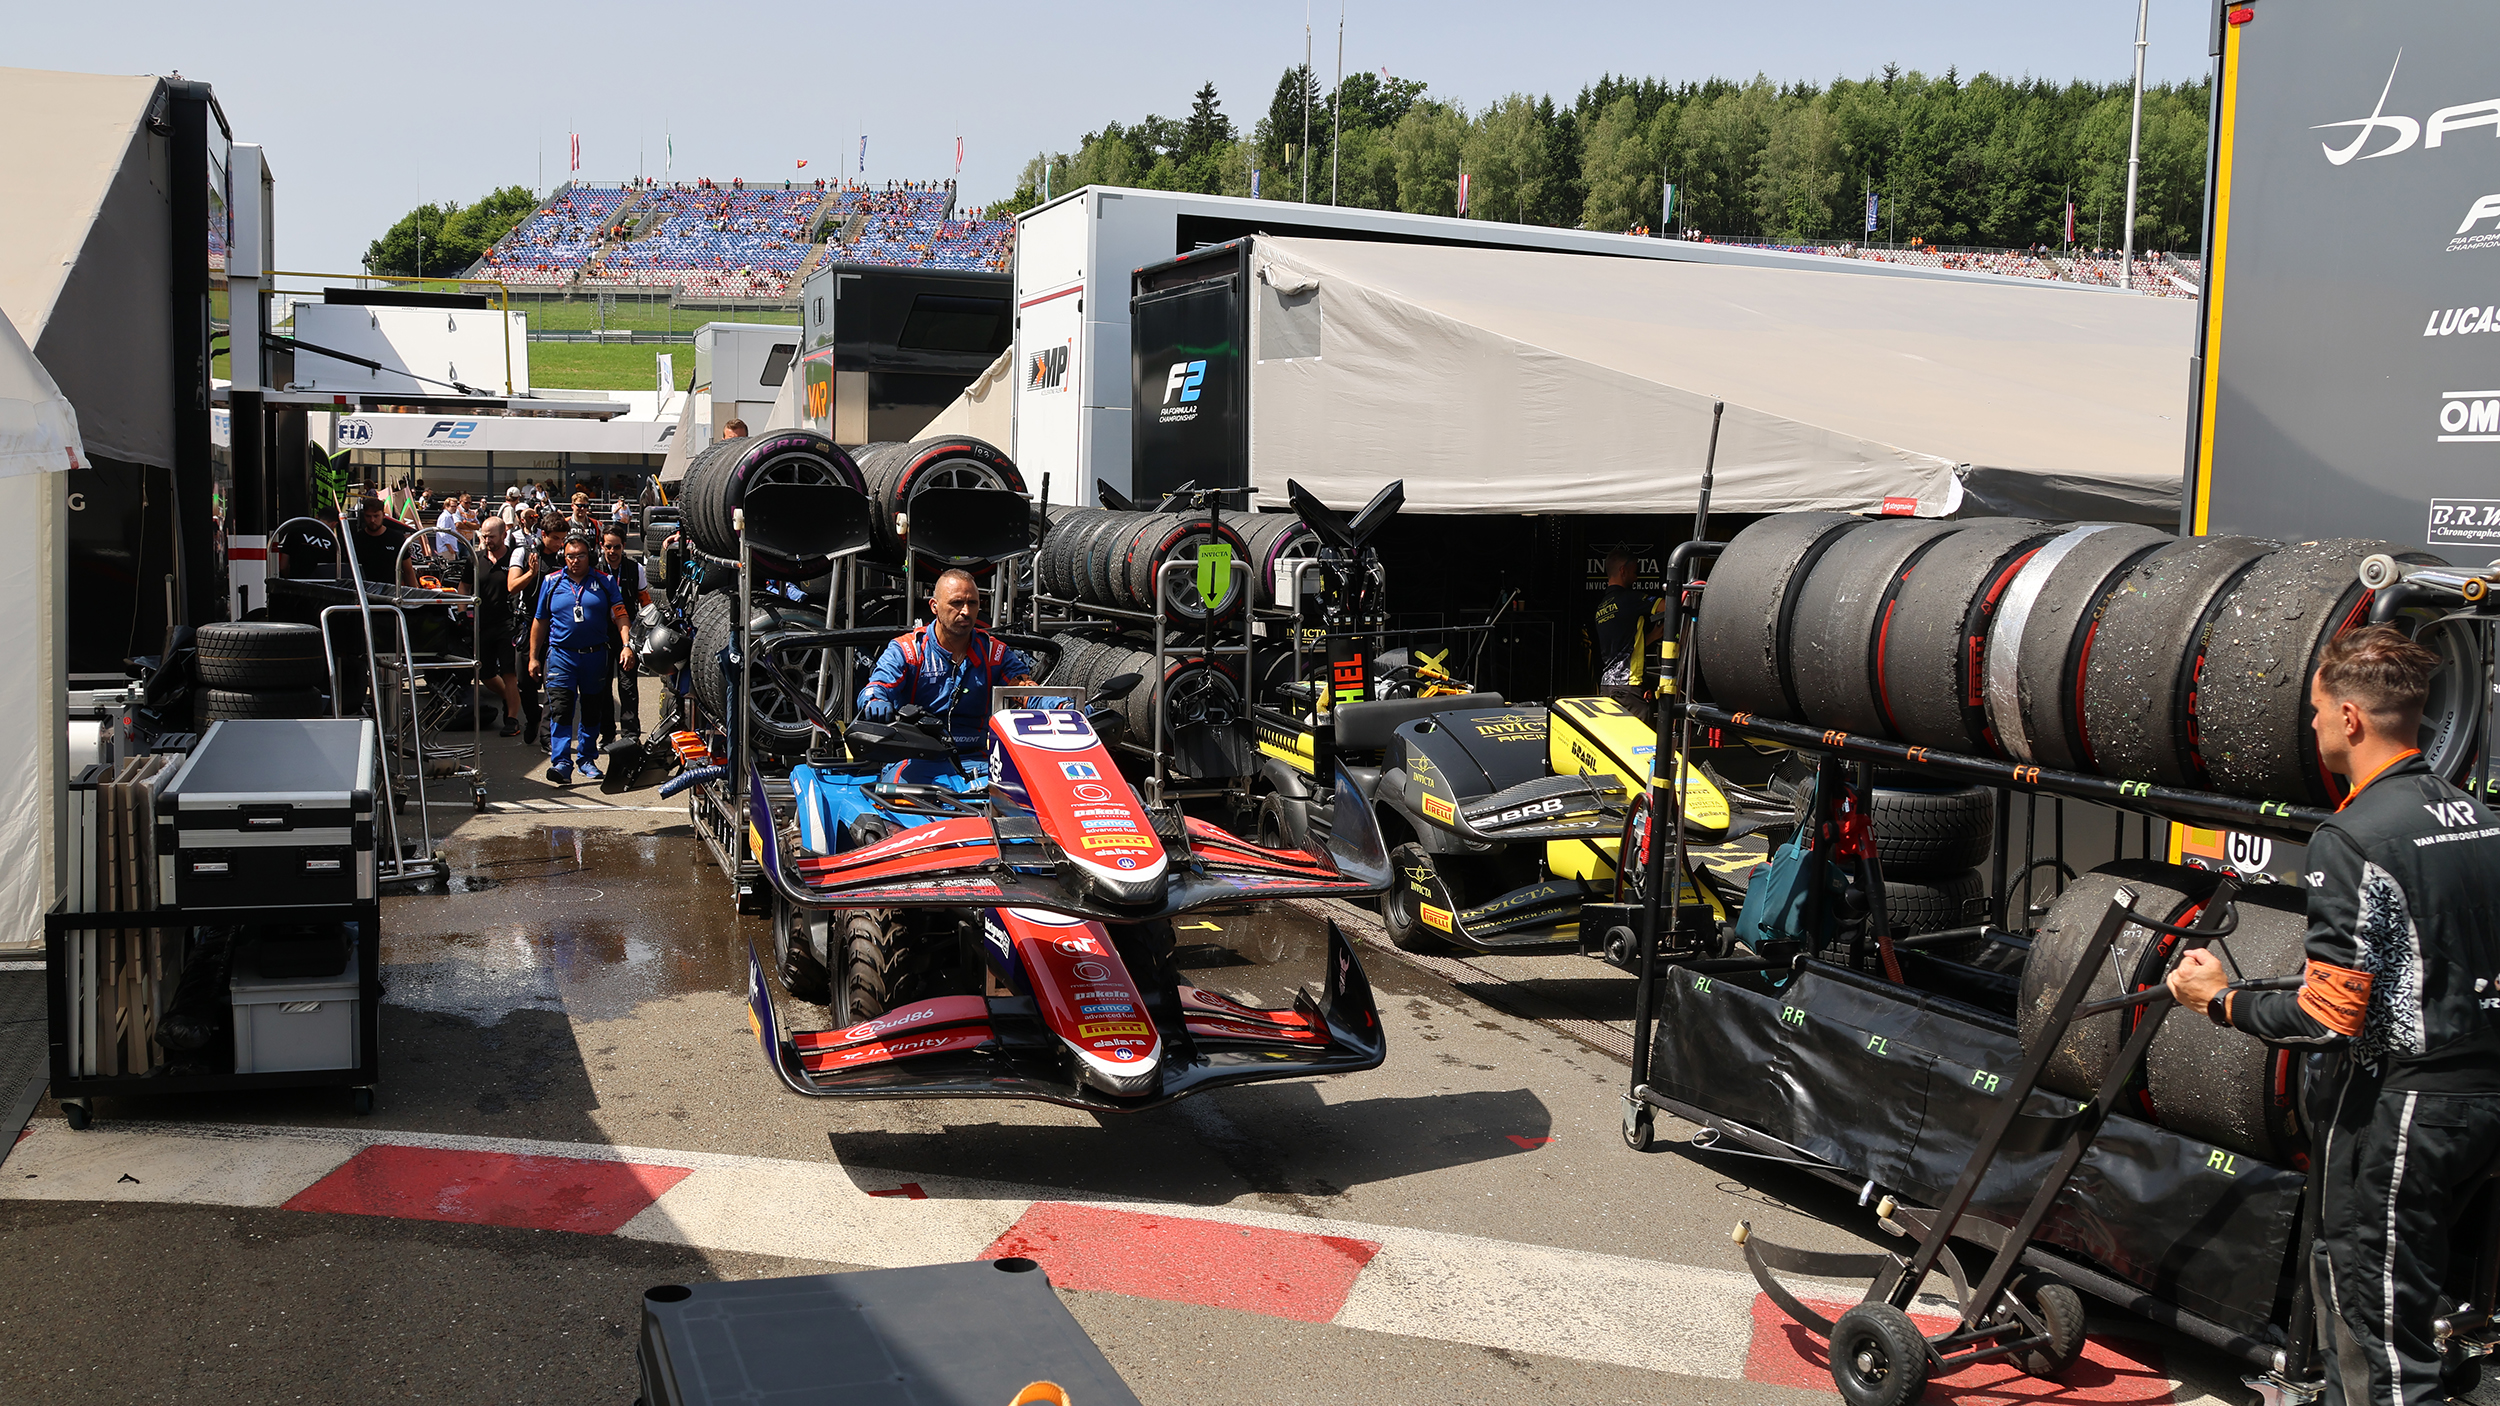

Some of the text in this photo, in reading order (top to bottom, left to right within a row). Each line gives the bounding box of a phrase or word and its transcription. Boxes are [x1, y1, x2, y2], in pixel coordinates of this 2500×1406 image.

[2456, 193, 2500, 235] F
[2450, 237, 2467, 245] FIA
[1163, 360, 1207, 405] F2
[2439, 399, 2500, 433] OM
[427, 421, 478, 439] F2
[1586, 558, 1660, 574] INTA
[1010, 710, 1093, 736] 23
[1475, 721, 1547, 735] INVICT
[1498, 734, 1547, 743] RACIN
[1822, 730, 1848, 748] RR
[2430, 710, 2454, 762] RACING
[1413, 772, 1435, 789] INVICTA
[2013, 765, 2040, 784] FR
[2119, 780, 2151, 798] FR
[1425, 798, 1453, 821] PIRELLI
[1502, 798, 1565, 822] BRB
[2259, 800, 2290, 818] FL
[1088, 836, 1146, 845] PIRELLI
[2413, 836, 2436, 847] VAN
[1094, 848, 1149, 857] dallara
[1461, 886, 1557, 919] INVICTA
[1423, 907, 1449, 929] PIRELLI
[1694, 976, 1712, 994] RL
[1074, 991, 1130, 1000] pakelo
[844, 1008, 934, 1040] Cloud86
[1084, 1012, 1121, 1020] advanced
[1781, 1005, 1806, 1026] RR
[1086, 1023, 1143, 1034] PIRELLI
[1093, 1038, 1147, 1048] dallara
[1866, 1034, 1889, 1056] FL
[1971, 1069, 2000, 1093] FR
[2206, 1149, 2237, 1175] RL
